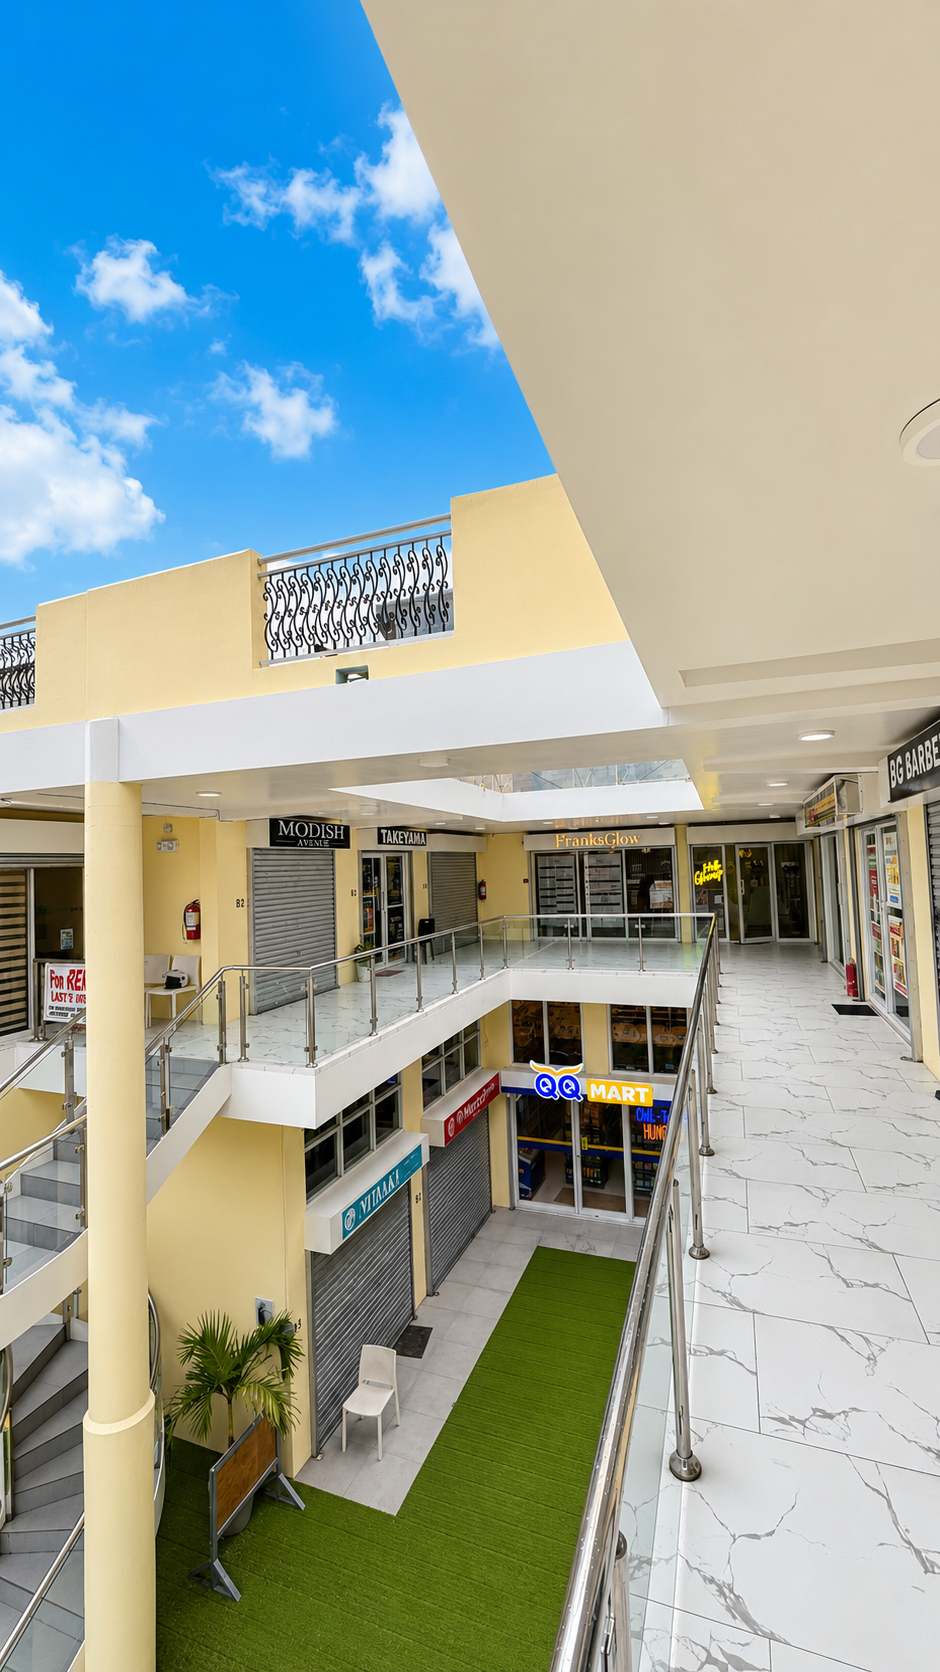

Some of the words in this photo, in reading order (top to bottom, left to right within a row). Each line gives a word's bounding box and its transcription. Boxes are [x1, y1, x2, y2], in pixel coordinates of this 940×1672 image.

[889, 755, 904, 789] BG
[905, 733, 940, 780] BARBE
[278, 820, 345, 840] MODISH
[381, 829, 426, 845] TAKEYAMA
[297, 839, 330, 848] AVENUE
[555, 832, 641, 849] FranksGlow
[235, 898, 245, 908] B2
[66, 968, 87, 992] REN
[51, 990, 67, 1004] LAST
[535, 1072, 583, 1102] QQ
[590, 1083, 650, 1103] MART
[643, 1123, 668, 1141] HUNG
